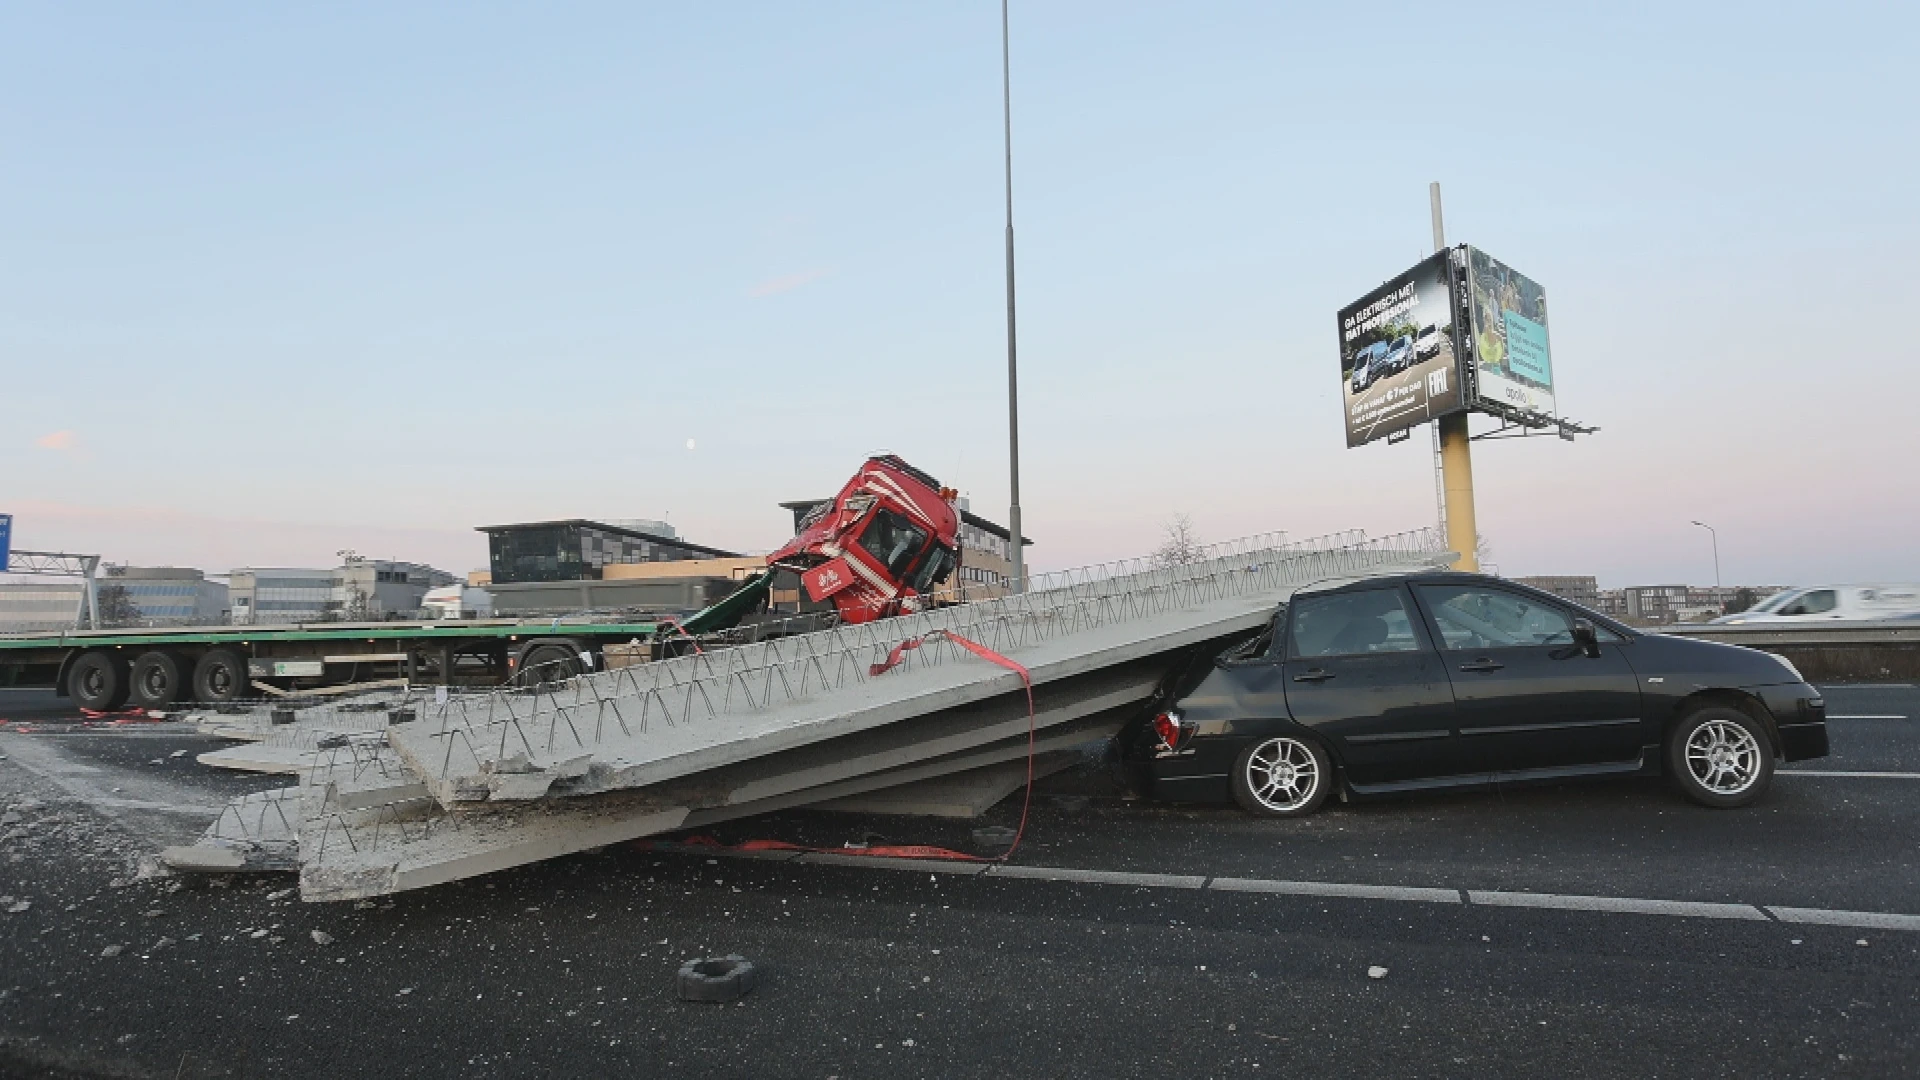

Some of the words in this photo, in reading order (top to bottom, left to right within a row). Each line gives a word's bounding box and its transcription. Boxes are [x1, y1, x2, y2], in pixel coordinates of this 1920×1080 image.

[1345, 325, 1362, 342] FIAT
[1361, 293, 1420, 334] PROFESSIONAL
[1356, 291, 1398, 324] ELEKTRISCH
[1398, 280, 1415, 300] MET
[1428, 366, 1449, 398] FIAT
